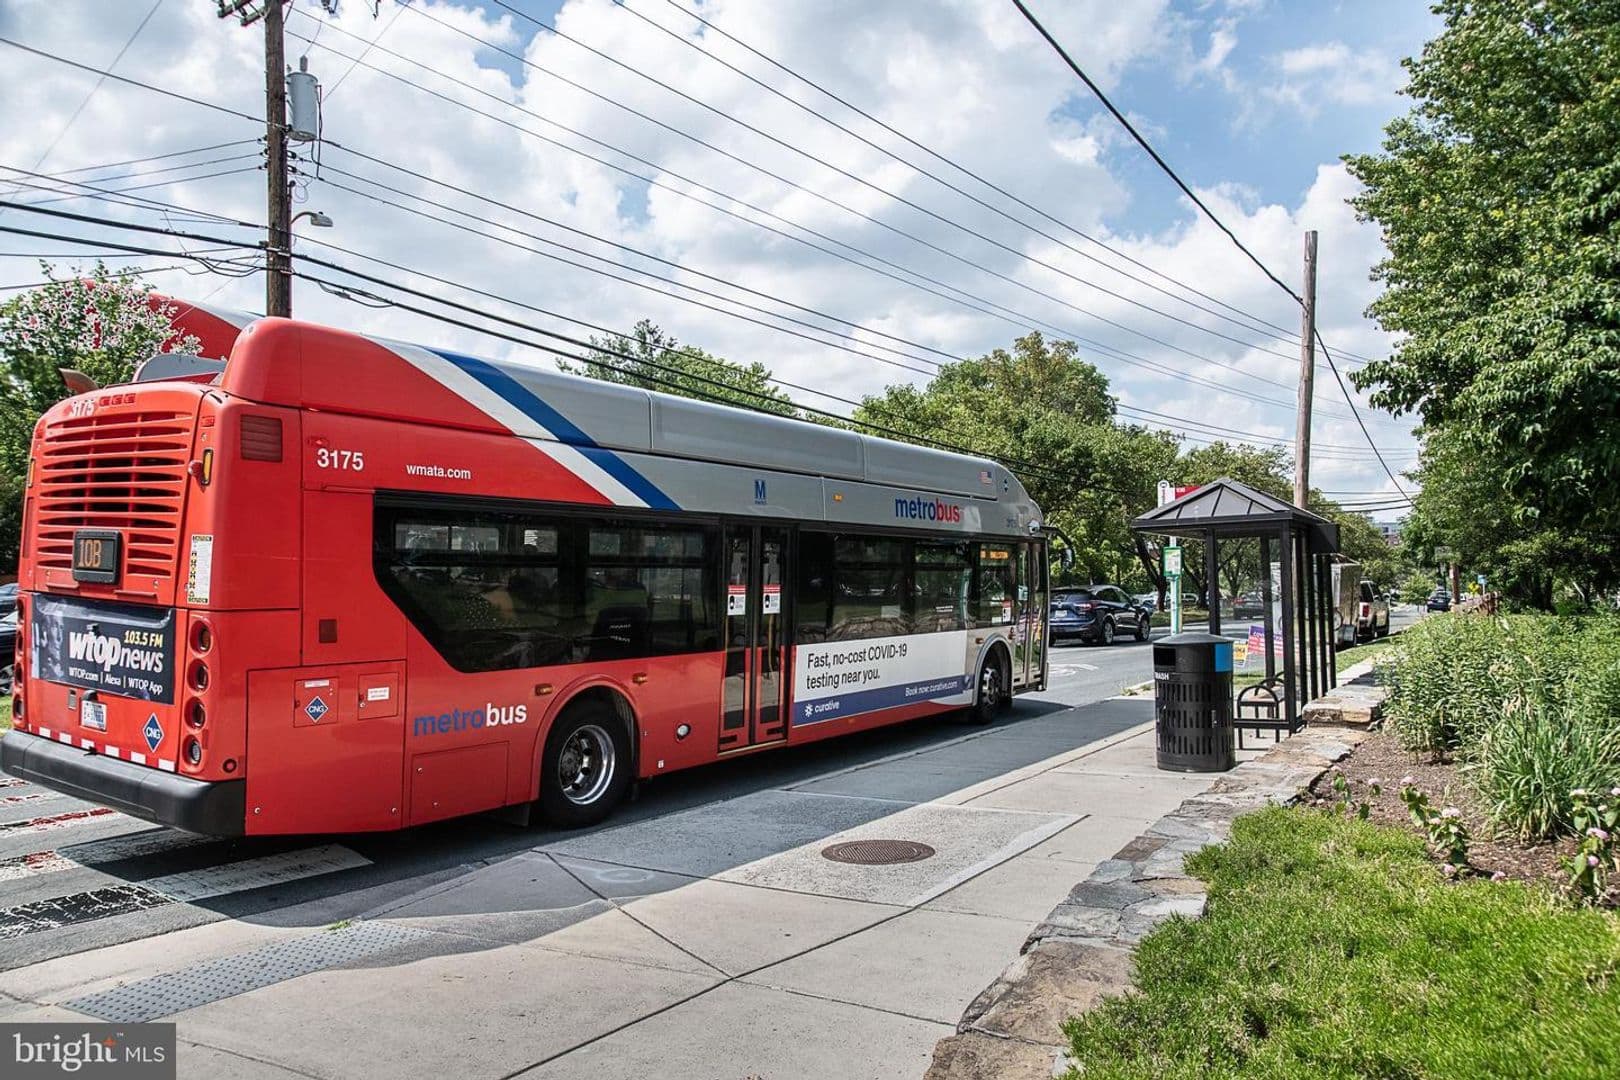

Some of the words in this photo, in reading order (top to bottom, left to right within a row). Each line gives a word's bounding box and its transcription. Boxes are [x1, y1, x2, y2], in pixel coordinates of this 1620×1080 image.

[316, 448, 364, 471] 3175
[406, 464, 472, 480] wmata.com
[895, 497, 961, 523] metrobus
[77, 539, 102, 568] 10B
[124, 630, 148, 646] 103.5
[148, 633, 164, 648] FM
[807, 652, 831, 669] Fast,
[833, 648, 867, 666] no-cost
[868, 643, 908, 661] COVID-19
[128, 677, 149, 690] WTOP
[148, 681, 163, 696] App
[806, 672, 840, 690] testing
[841, 670, 862, 685] near
[862, 668, 881, 685] you.
[307, 704, 325, 714] CNG
[814, 700, 840, 712] curative
[414, 702, 528, 737] metrobus
[145, 727, 161, 740] CNG
